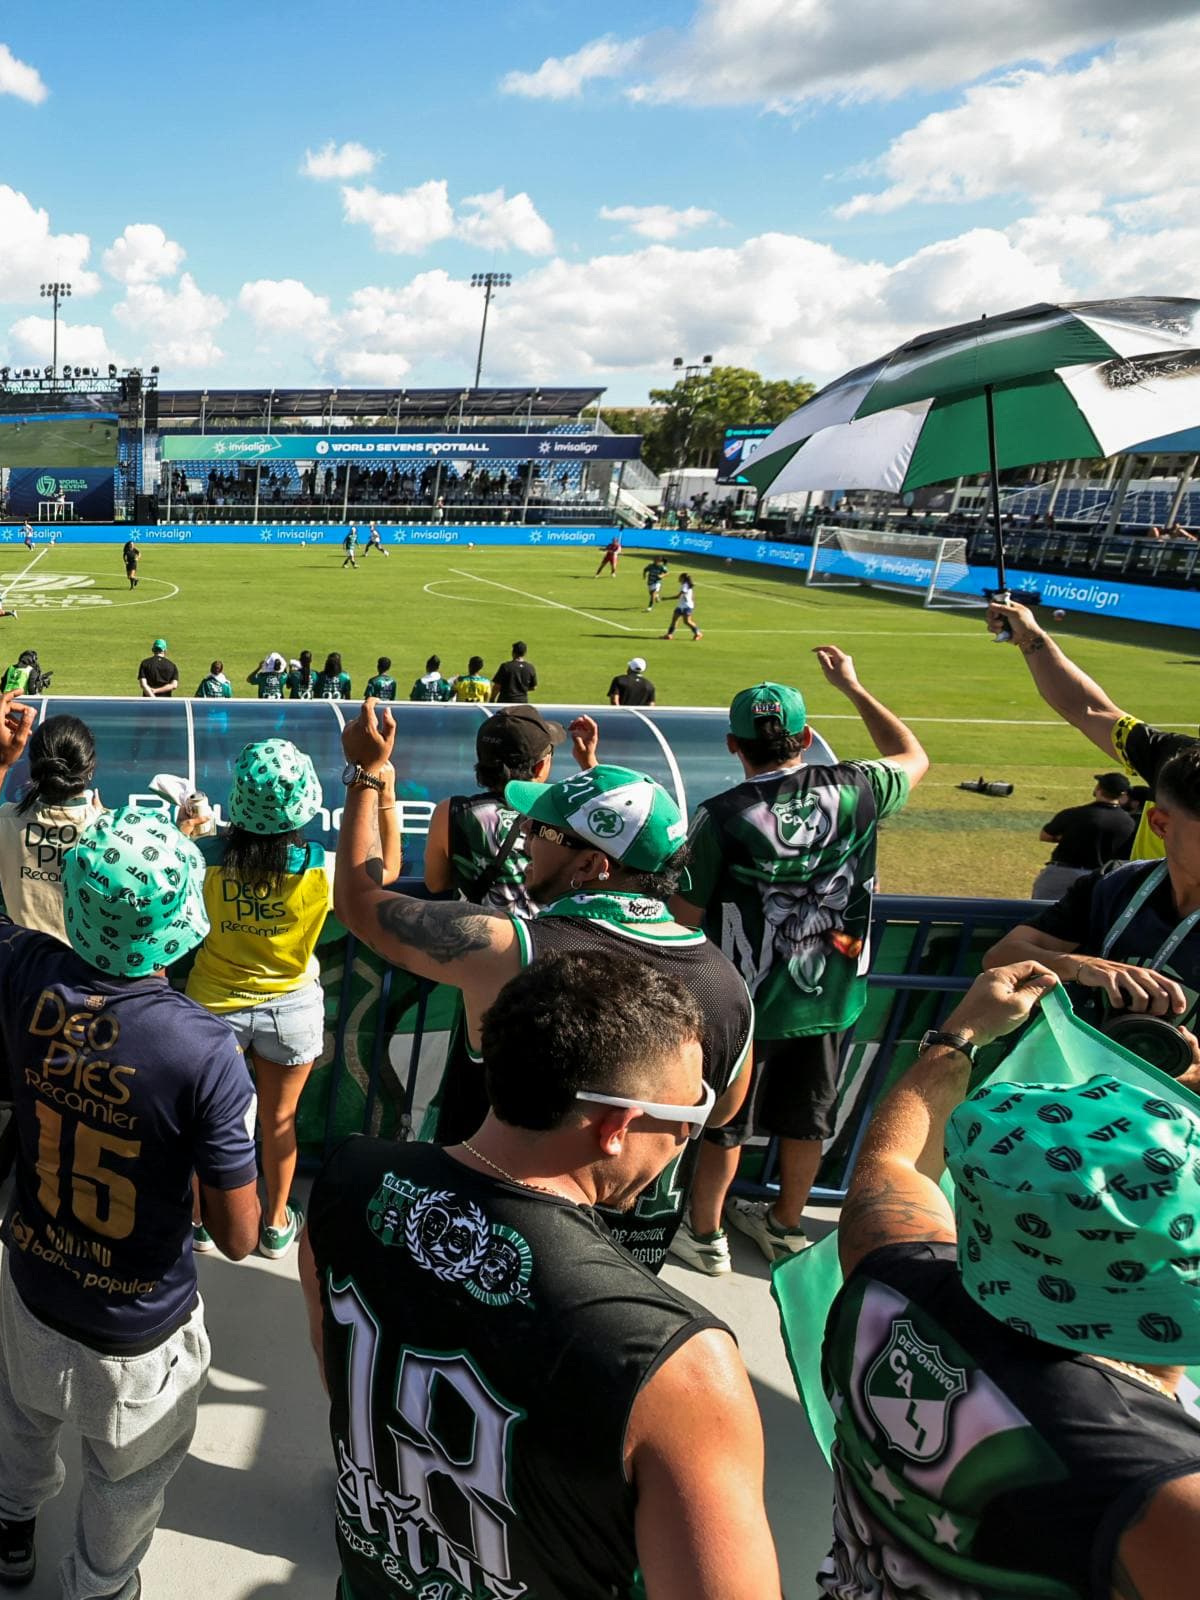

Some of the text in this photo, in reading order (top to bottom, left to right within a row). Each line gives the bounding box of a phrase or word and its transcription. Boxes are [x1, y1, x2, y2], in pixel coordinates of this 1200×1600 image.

[228, 442, 272, 453] invisalign
[332, 443, 490, 452] WORLD SEVENS FOOTBALL
[554, 441, 598, 454] invisalign
[17, 528, 62, 541] insalign
[145, 527, 192, 540] invisalign
[277, 528, 324, 541] invisalign
[411, 529, 458, 541] invisalign
[547, 530, 596, 542] invisalign
[1043, 580, 1120, 608] invisalign
[25, 822, 78, 848] DEO
[781, 812, 821, 836] CALI
[222, 878, 272, 902] DEO
[28, 990, 120, 1051] DEO
[24, 1066, 141, 1131] Recamier
[34, 1099, 142, 1241] 15
[82, 1272, 160, 1296] popular
[897, 1334, 955, 1391] DEPORTIVO
[889, 1348, 928, 1452] CALI
